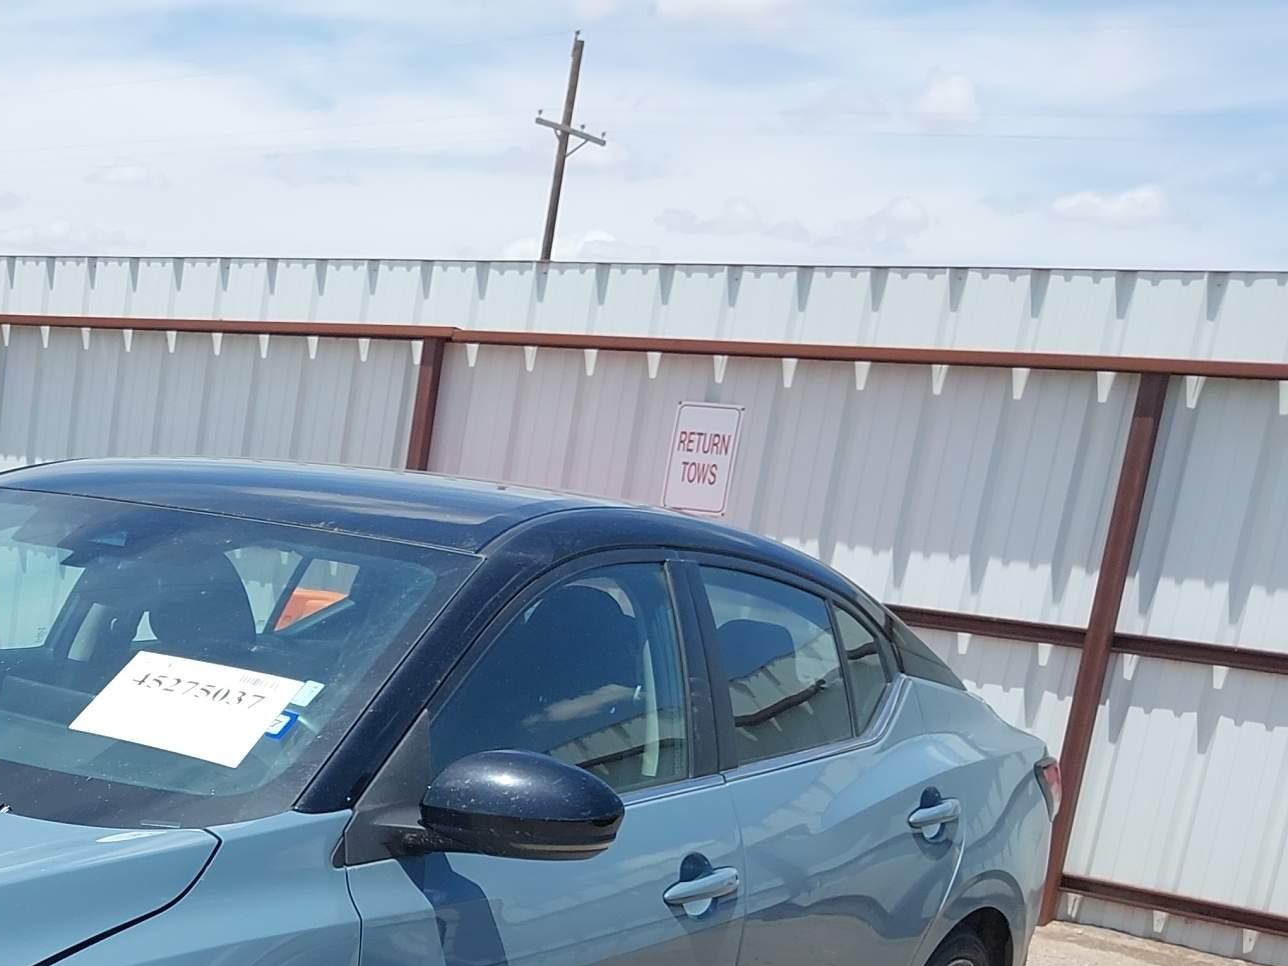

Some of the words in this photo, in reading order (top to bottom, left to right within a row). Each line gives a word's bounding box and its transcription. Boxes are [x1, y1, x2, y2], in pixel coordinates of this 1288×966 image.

[677, 431, 731, 456] RETURN
[681, 461, 718, 486] TOWS
[132, 672, 266, 709] 45275037
